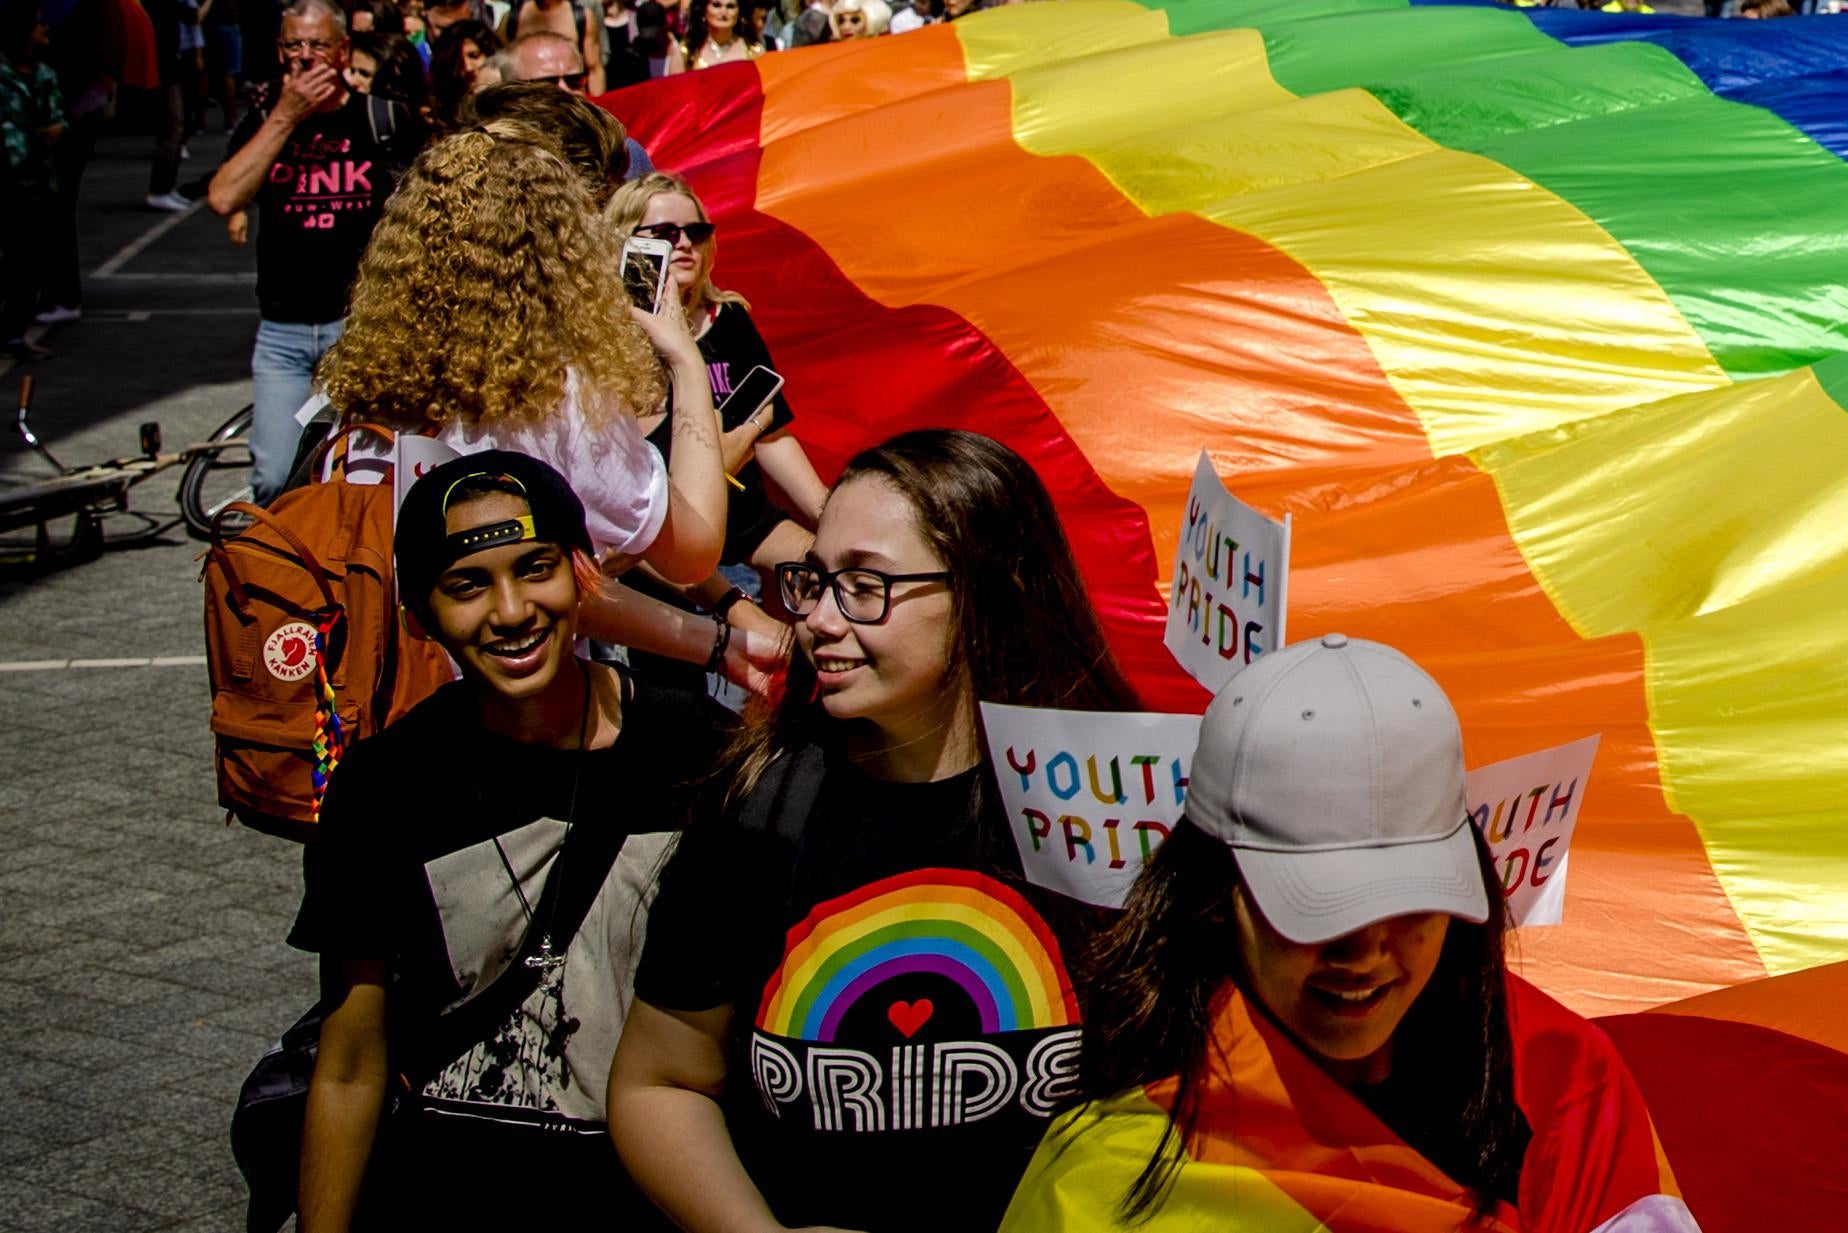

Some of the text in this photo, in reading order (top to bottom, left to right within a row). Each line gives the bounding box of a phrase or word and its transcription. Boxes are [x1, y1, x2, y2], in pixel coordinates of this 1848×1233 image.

[1186, 495, 1264, 609] YOUTH
[1021, 808, 1171, 869] PRID
[752, 1028, 1083, 1133] PRIDE
